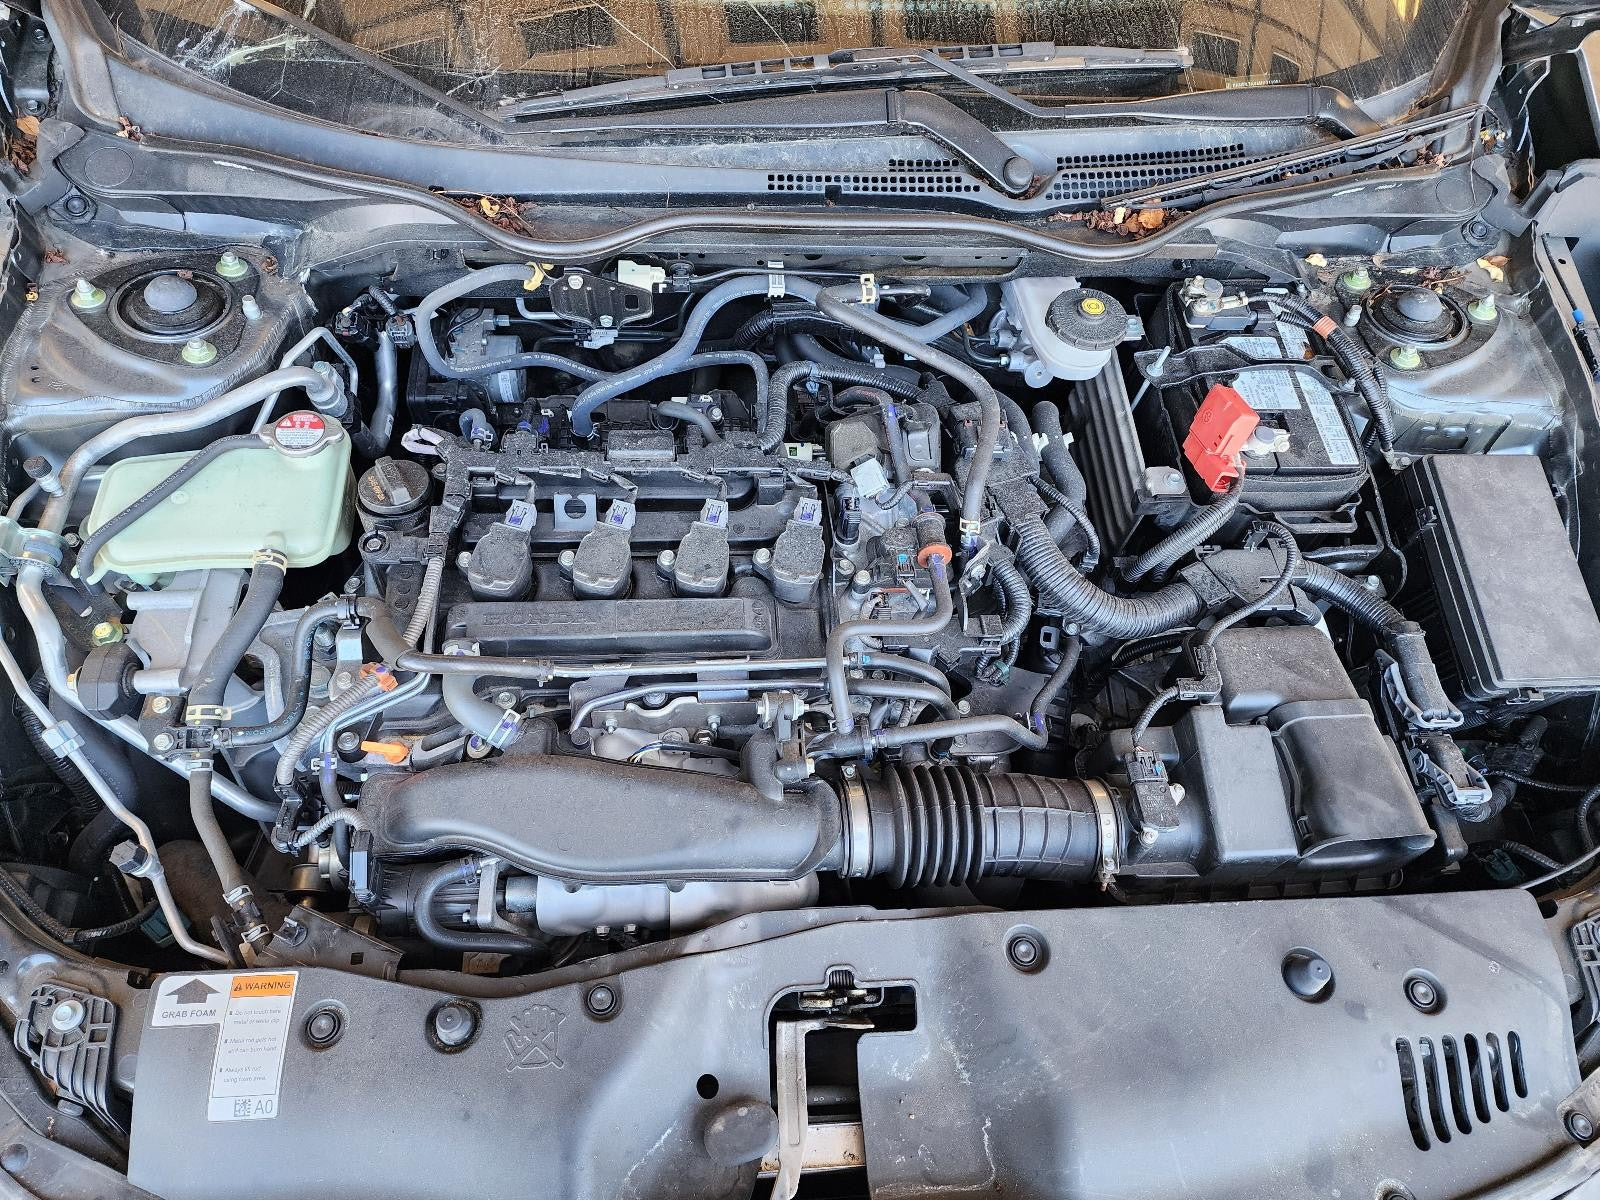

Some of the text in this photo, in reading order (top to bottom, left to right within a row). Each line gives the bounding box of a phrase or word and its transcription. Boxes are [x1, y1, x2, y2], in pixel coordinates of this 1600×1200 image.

[245, 981, 291, 991] WARNING
[161, 1009, 217, 1019] GRAB FOAM
